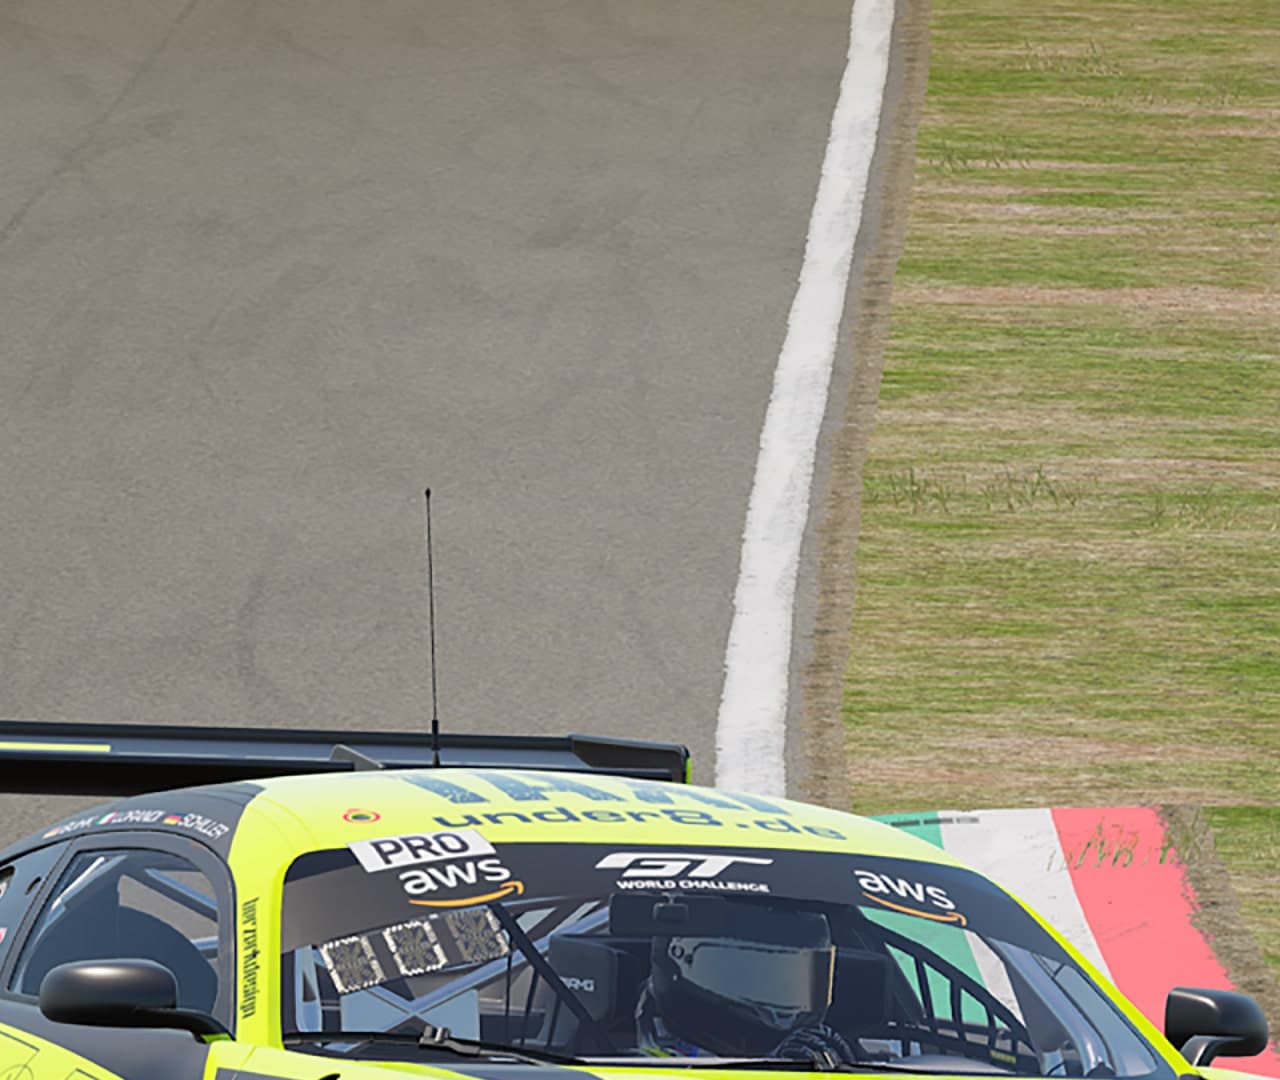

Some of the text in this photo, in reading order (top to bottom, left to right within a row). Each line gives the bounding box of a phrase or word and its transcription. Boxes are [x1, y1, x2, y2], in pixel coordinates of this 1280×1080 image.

[434, 806, 848, 840] under8.de
[370, 832, 471, 865] PRO
[399, 859, 512, 895] aws
[595, 853, 774, 878] GT
[616, 880, 770, 893] WORLD CHALLENGE
[854, 869, 957, 910] aws
